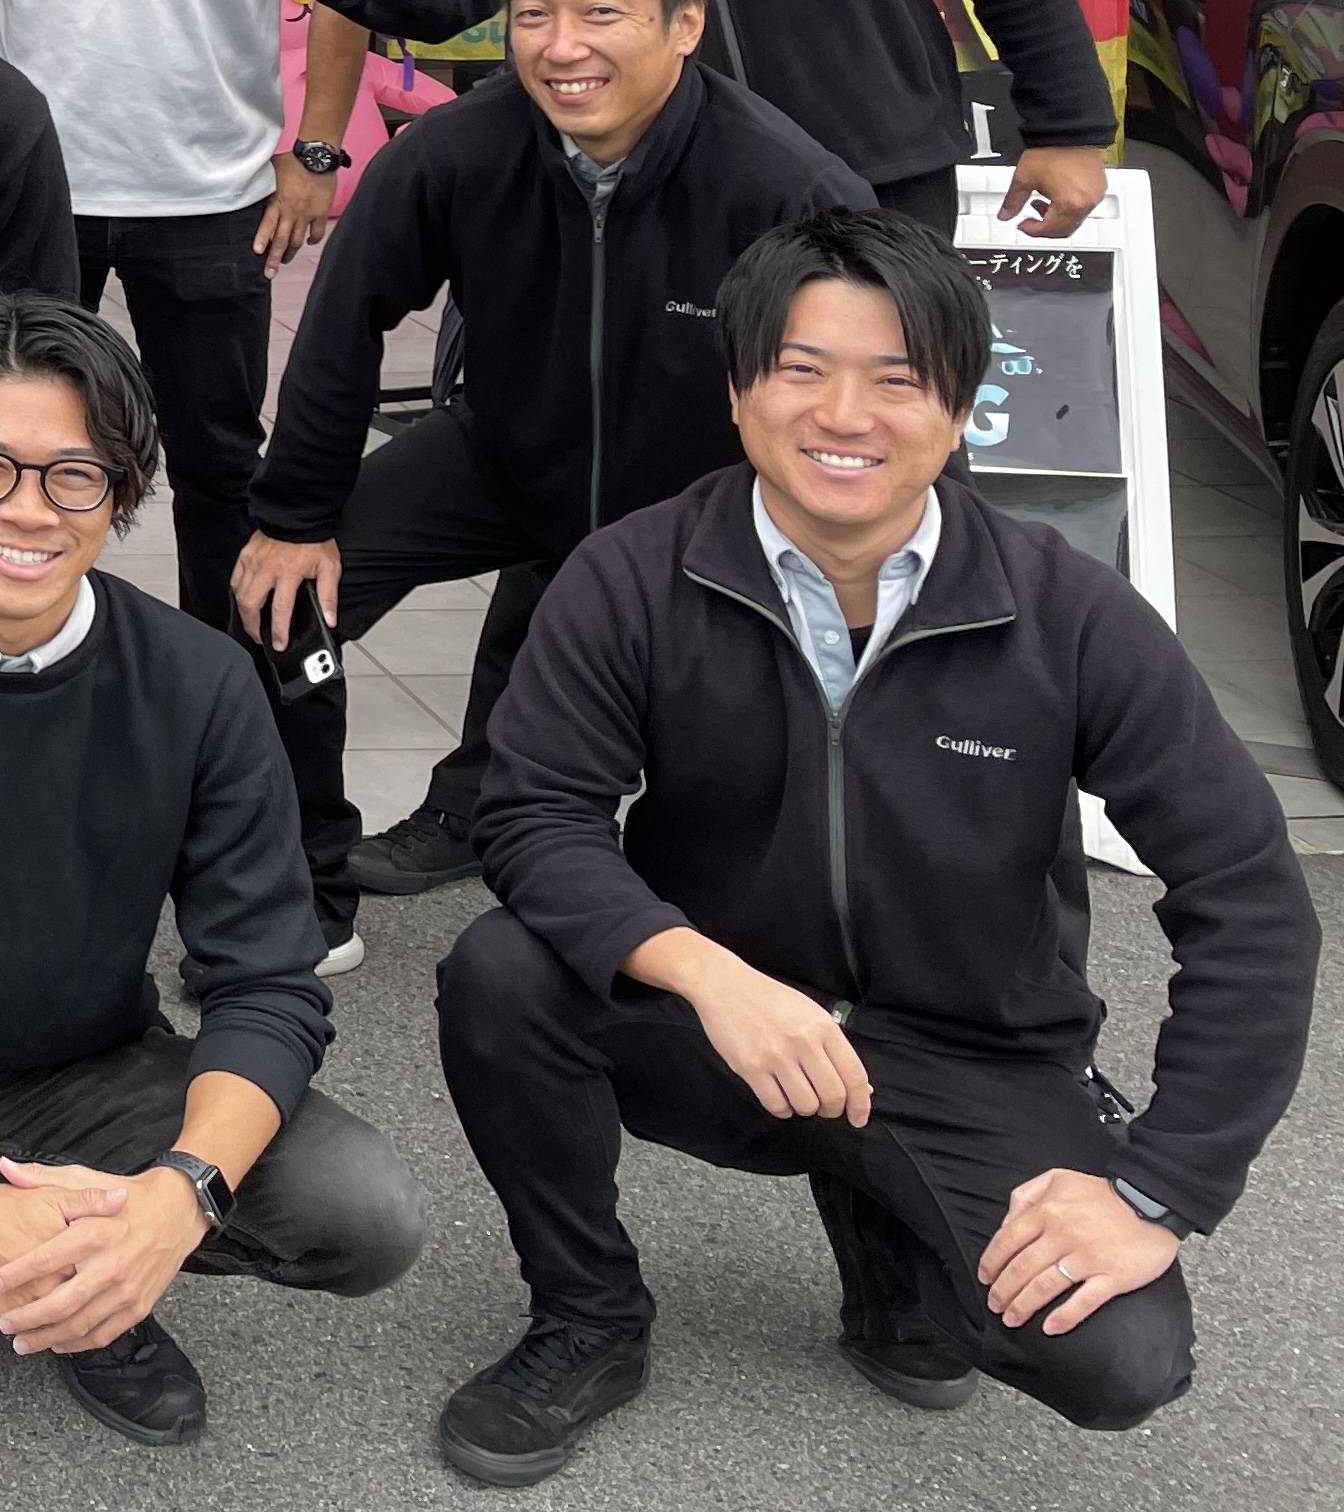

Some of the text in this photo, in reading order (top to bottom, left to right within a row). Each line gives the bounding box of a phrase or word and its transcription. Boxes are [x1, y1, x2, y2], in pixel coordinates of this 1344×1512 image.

[968, 254, 1083, 279] ーティングを
[935, 735, 1018, 761] Gulliver
